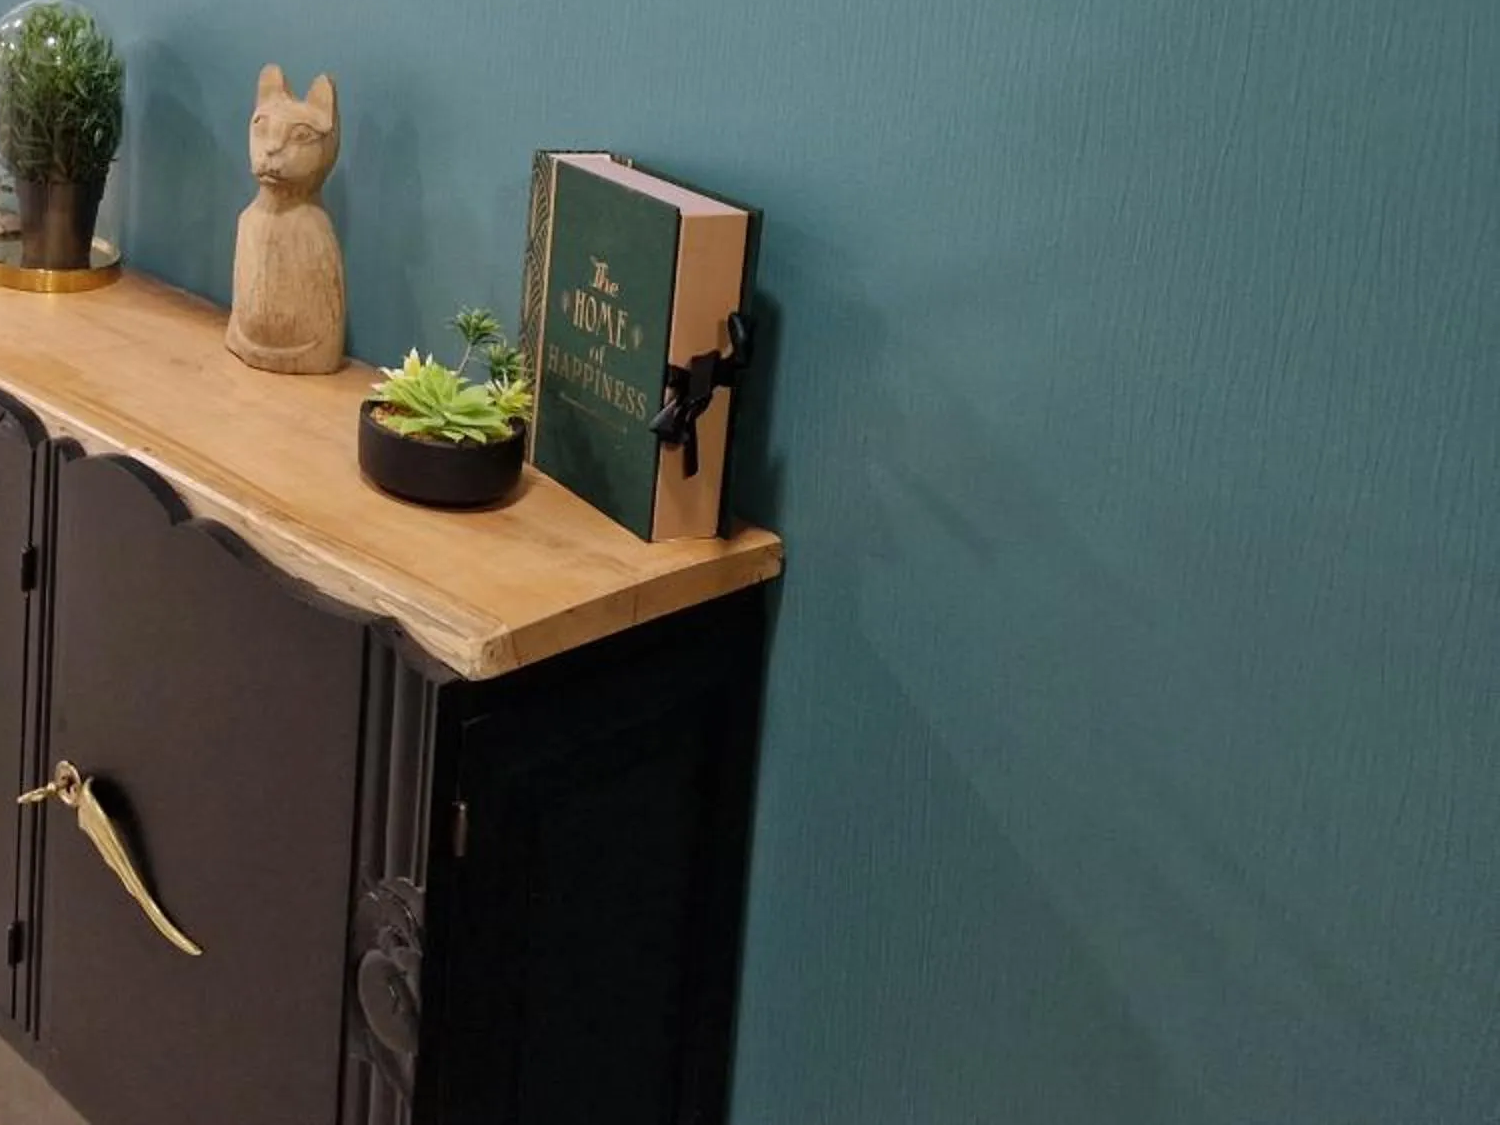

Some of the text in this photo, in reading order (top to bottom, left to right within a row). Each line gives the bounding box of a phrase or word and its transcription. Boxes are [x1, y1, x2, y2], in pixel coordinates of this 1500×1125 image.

[589, 255, 620, 298] The
[572, 287, 629, 351] HOME
[547, 342, 648, 422] HAPPINESS
